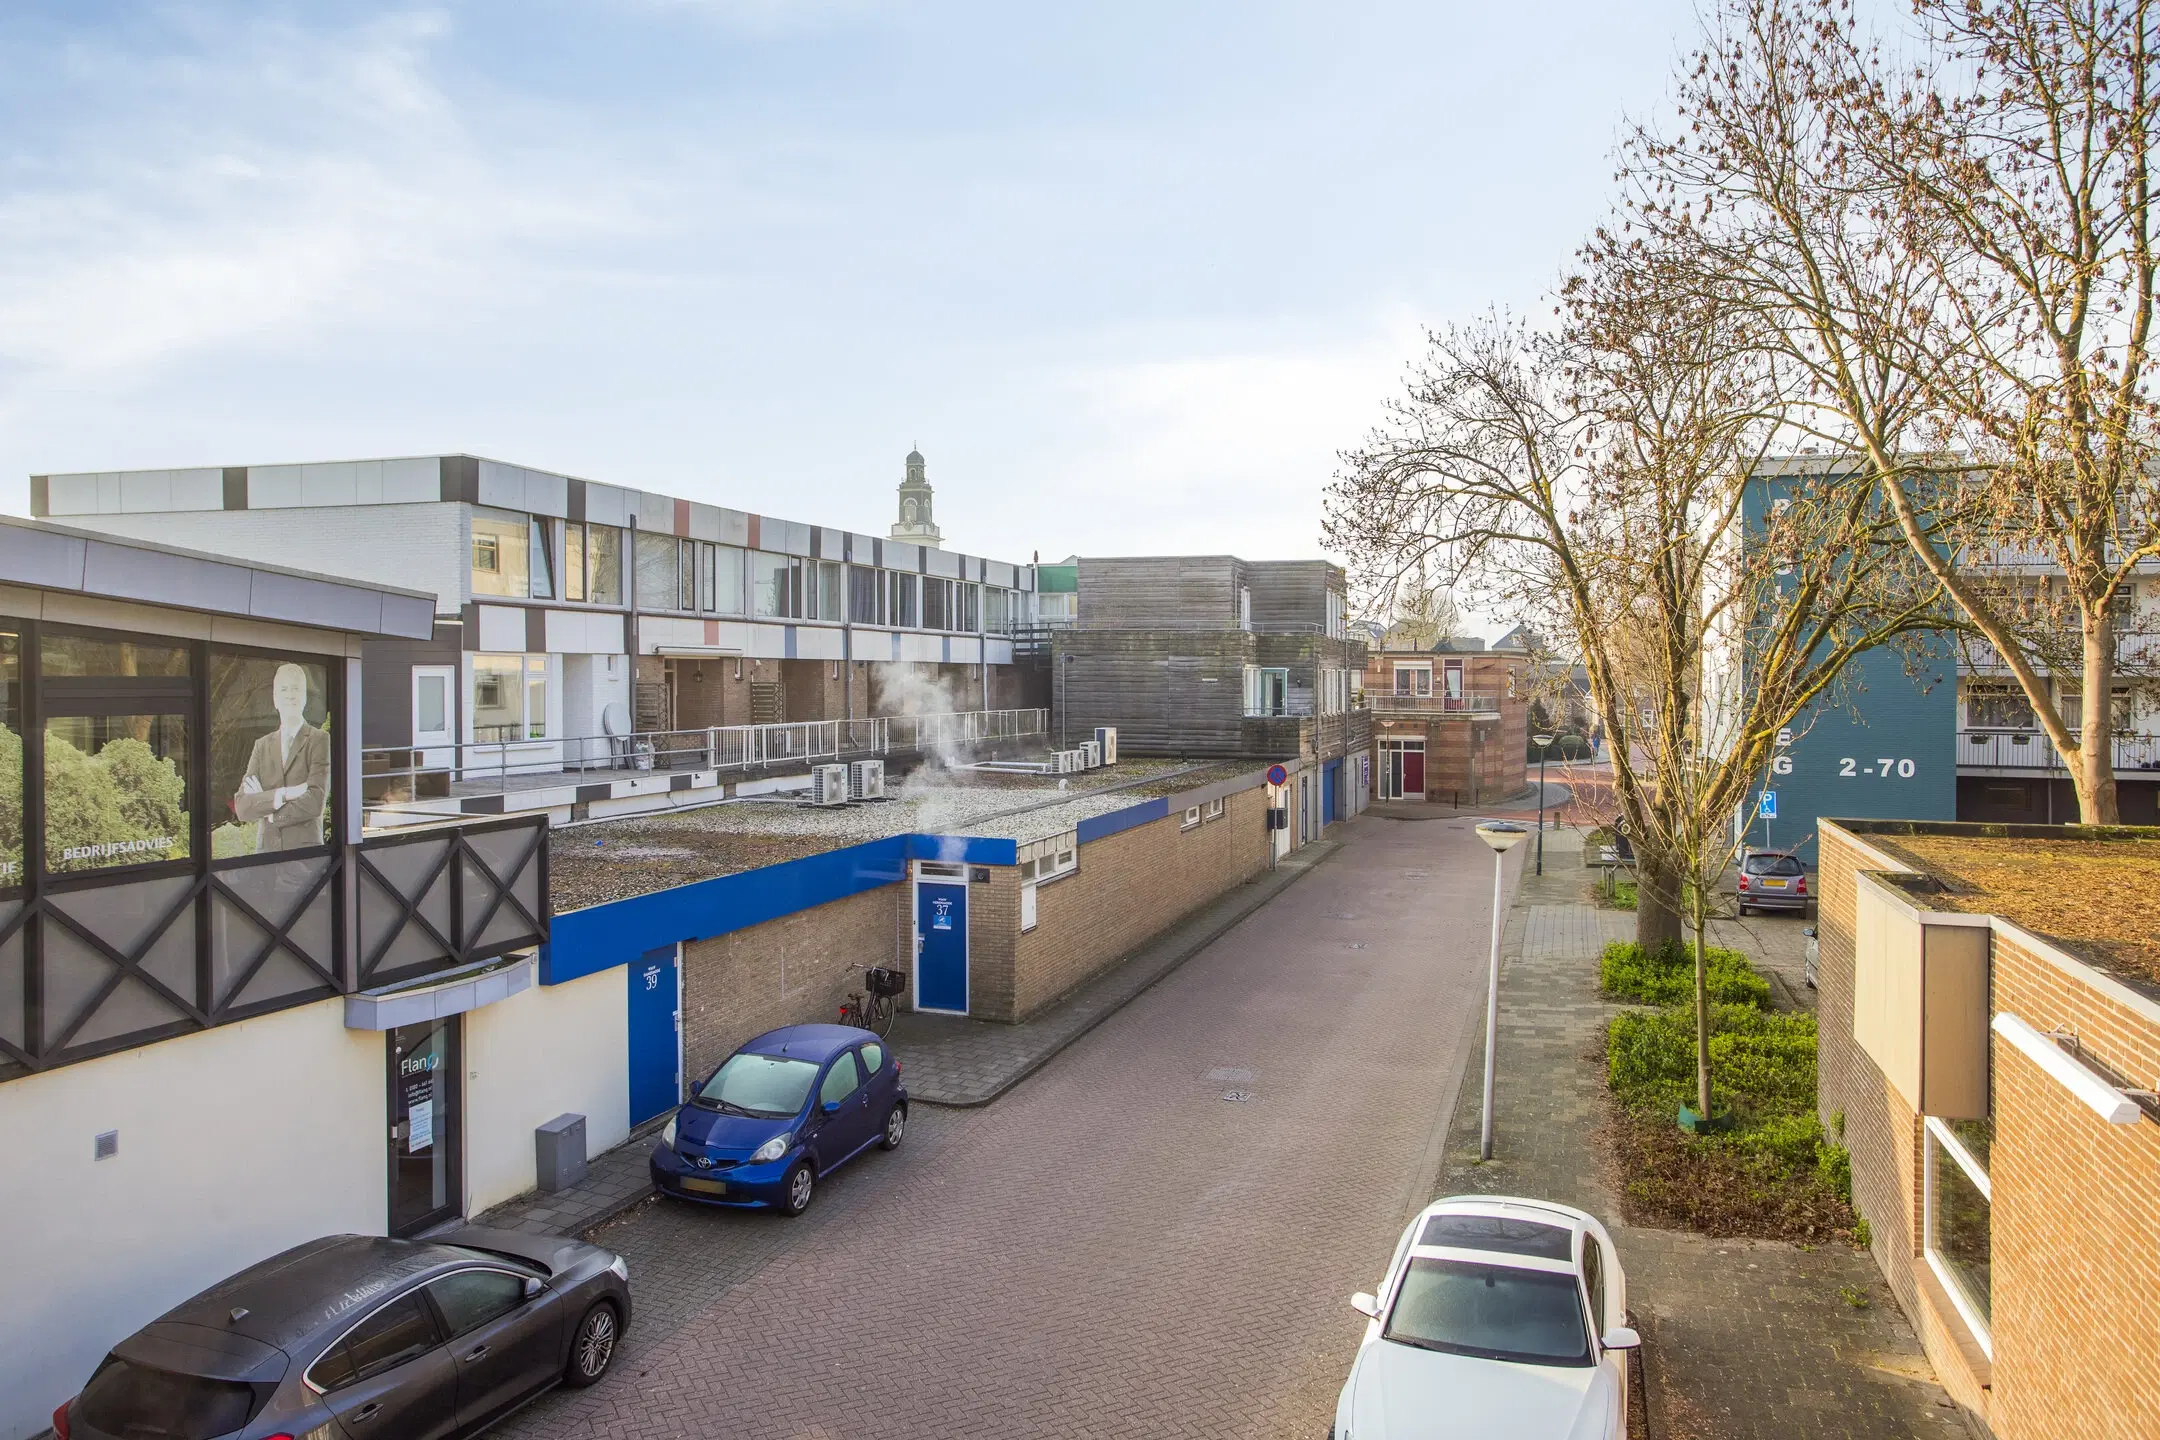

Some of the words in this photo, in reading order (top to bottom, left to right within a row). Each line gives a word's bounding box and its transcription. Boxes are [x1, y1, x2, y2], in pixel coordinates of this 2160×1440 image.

[1763, 793, 1773, 806] P
[63, 836, 173, 860] BEDRIJFSADVIES
[936, 904, 949, 916] 37
[646, 974, 657, 990] 39
